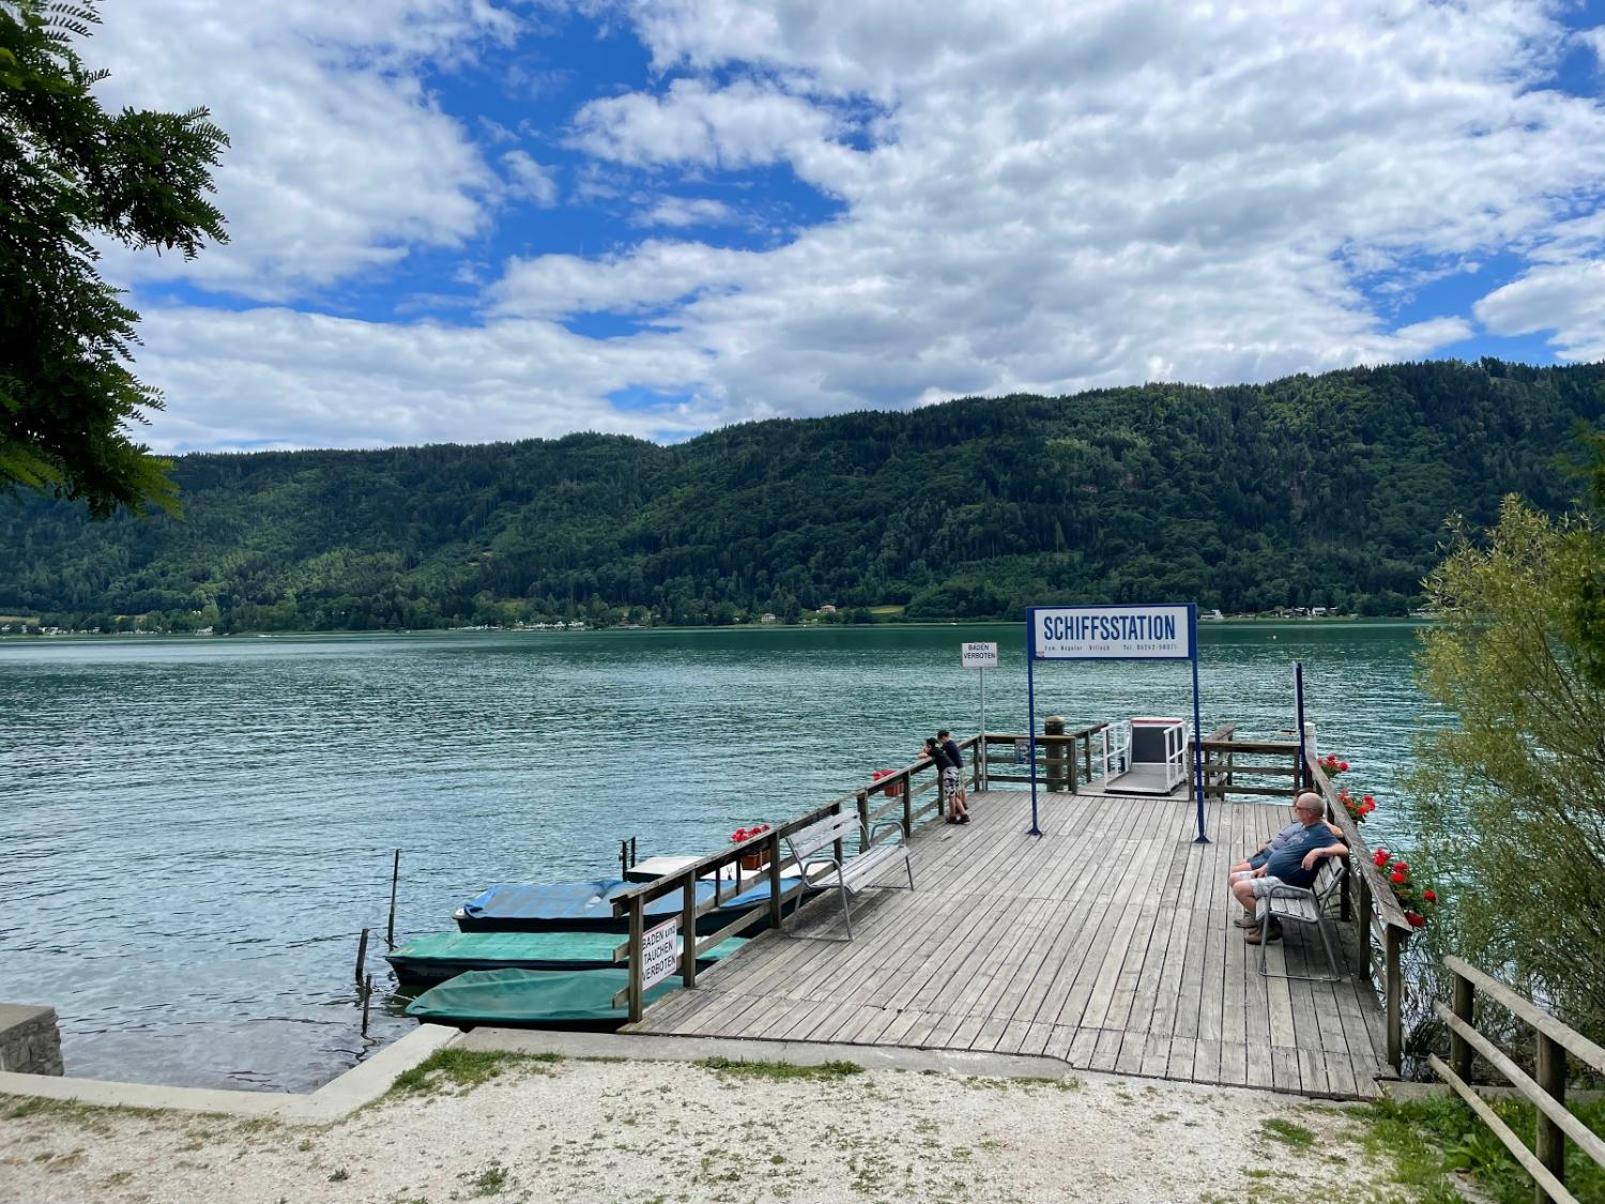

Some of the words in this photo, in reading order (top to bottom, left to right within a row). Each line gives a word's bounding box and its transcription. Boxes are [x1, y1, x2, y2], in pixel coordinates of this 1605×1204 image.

[1043, 615, 1175, 641] SCHIFFSSTATION
[643, 940, 673, 965] TAUCHEN
[641, 954, 676, 981] VERBOTEN
